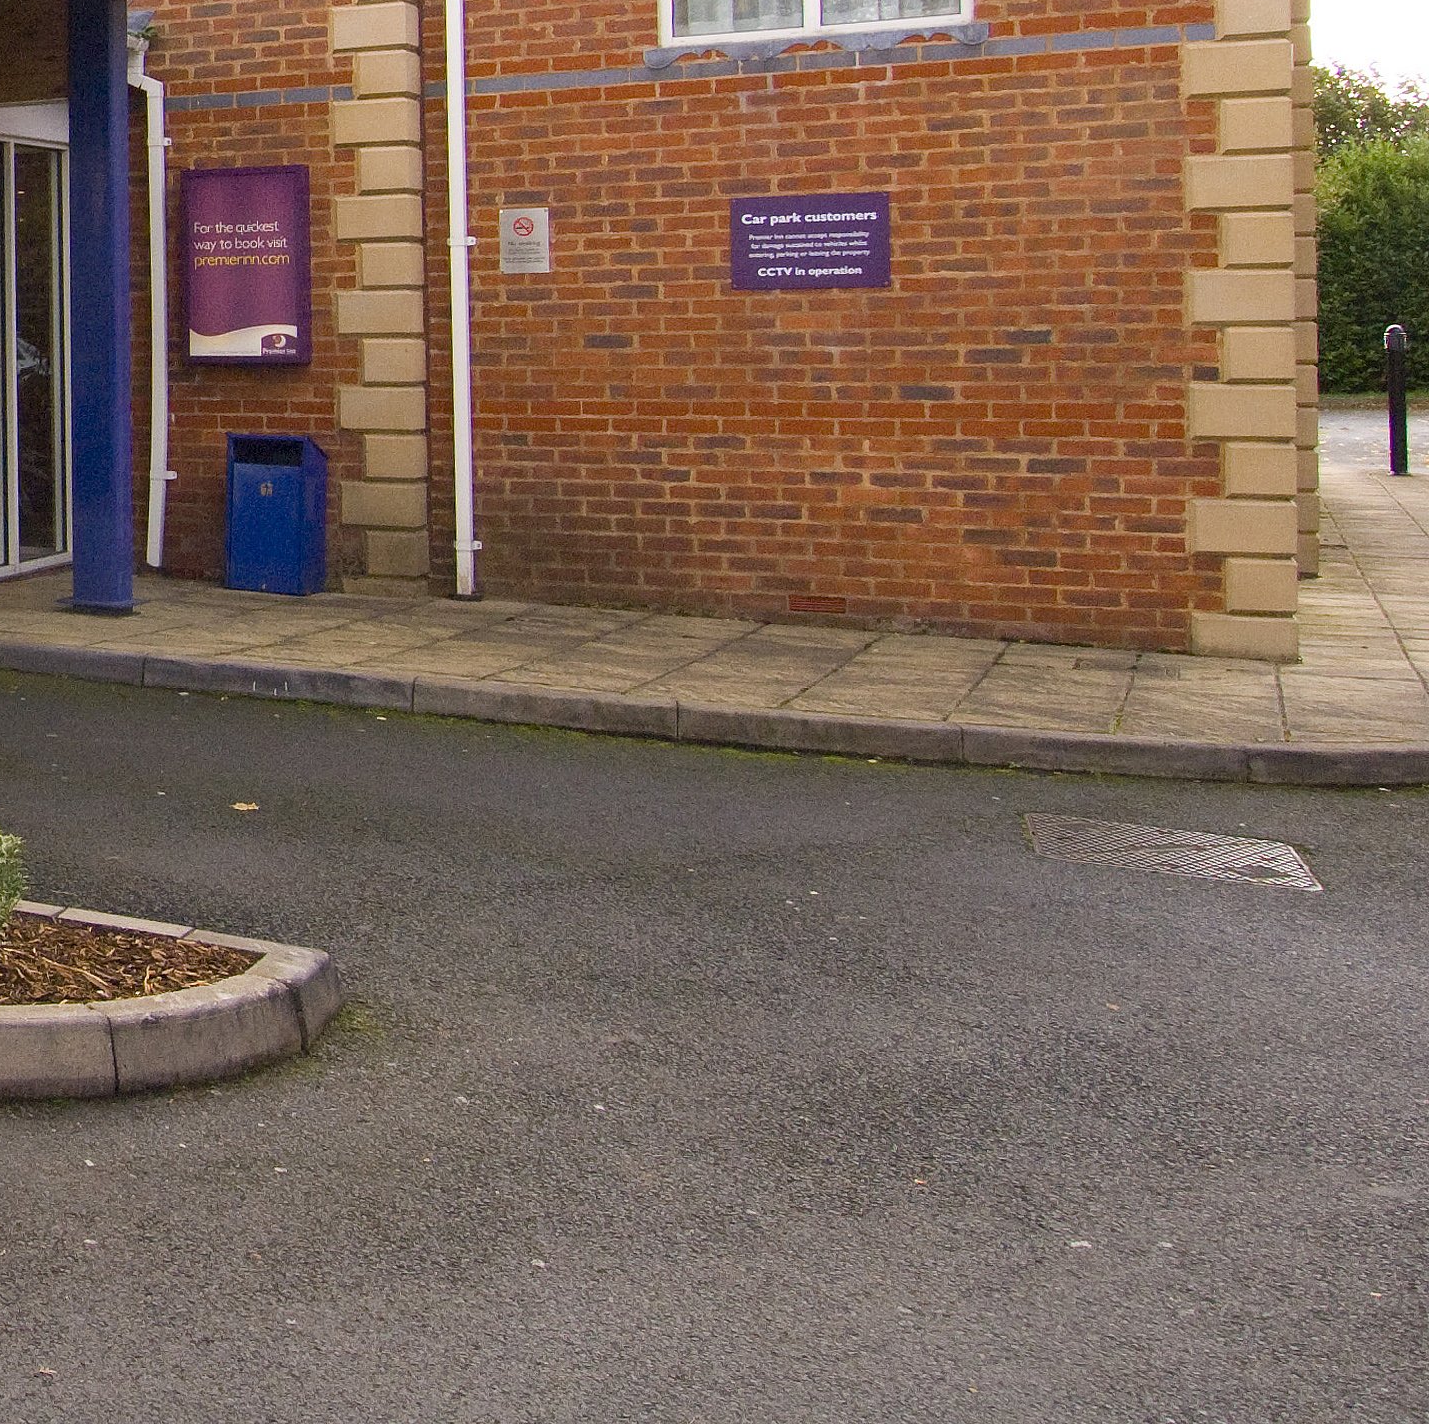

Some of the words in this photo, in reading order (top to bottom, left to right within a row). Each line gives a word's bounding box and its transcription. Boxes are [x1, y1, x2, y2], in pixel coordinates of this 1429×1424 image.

[741, 213, 767, 225] Car
[770, 212, 802, 226] park
[804, 211, 877, 223] customers
[193, 221, 213, 234] For
[215, 221, 234, 234] the
[235, 220, 280, 236] quickest
[193, 240, 217, 253] way
[220, 238, 233, 250] to
[234, 236, 265, 249] book
[266, 235, 289, 248] visit
[194, 252, 290, 271] premierinn.com
[757, 266, 793, 277] CCTV
[794, 266, 806, 276] in
[808, 265, 863, 278] operation
